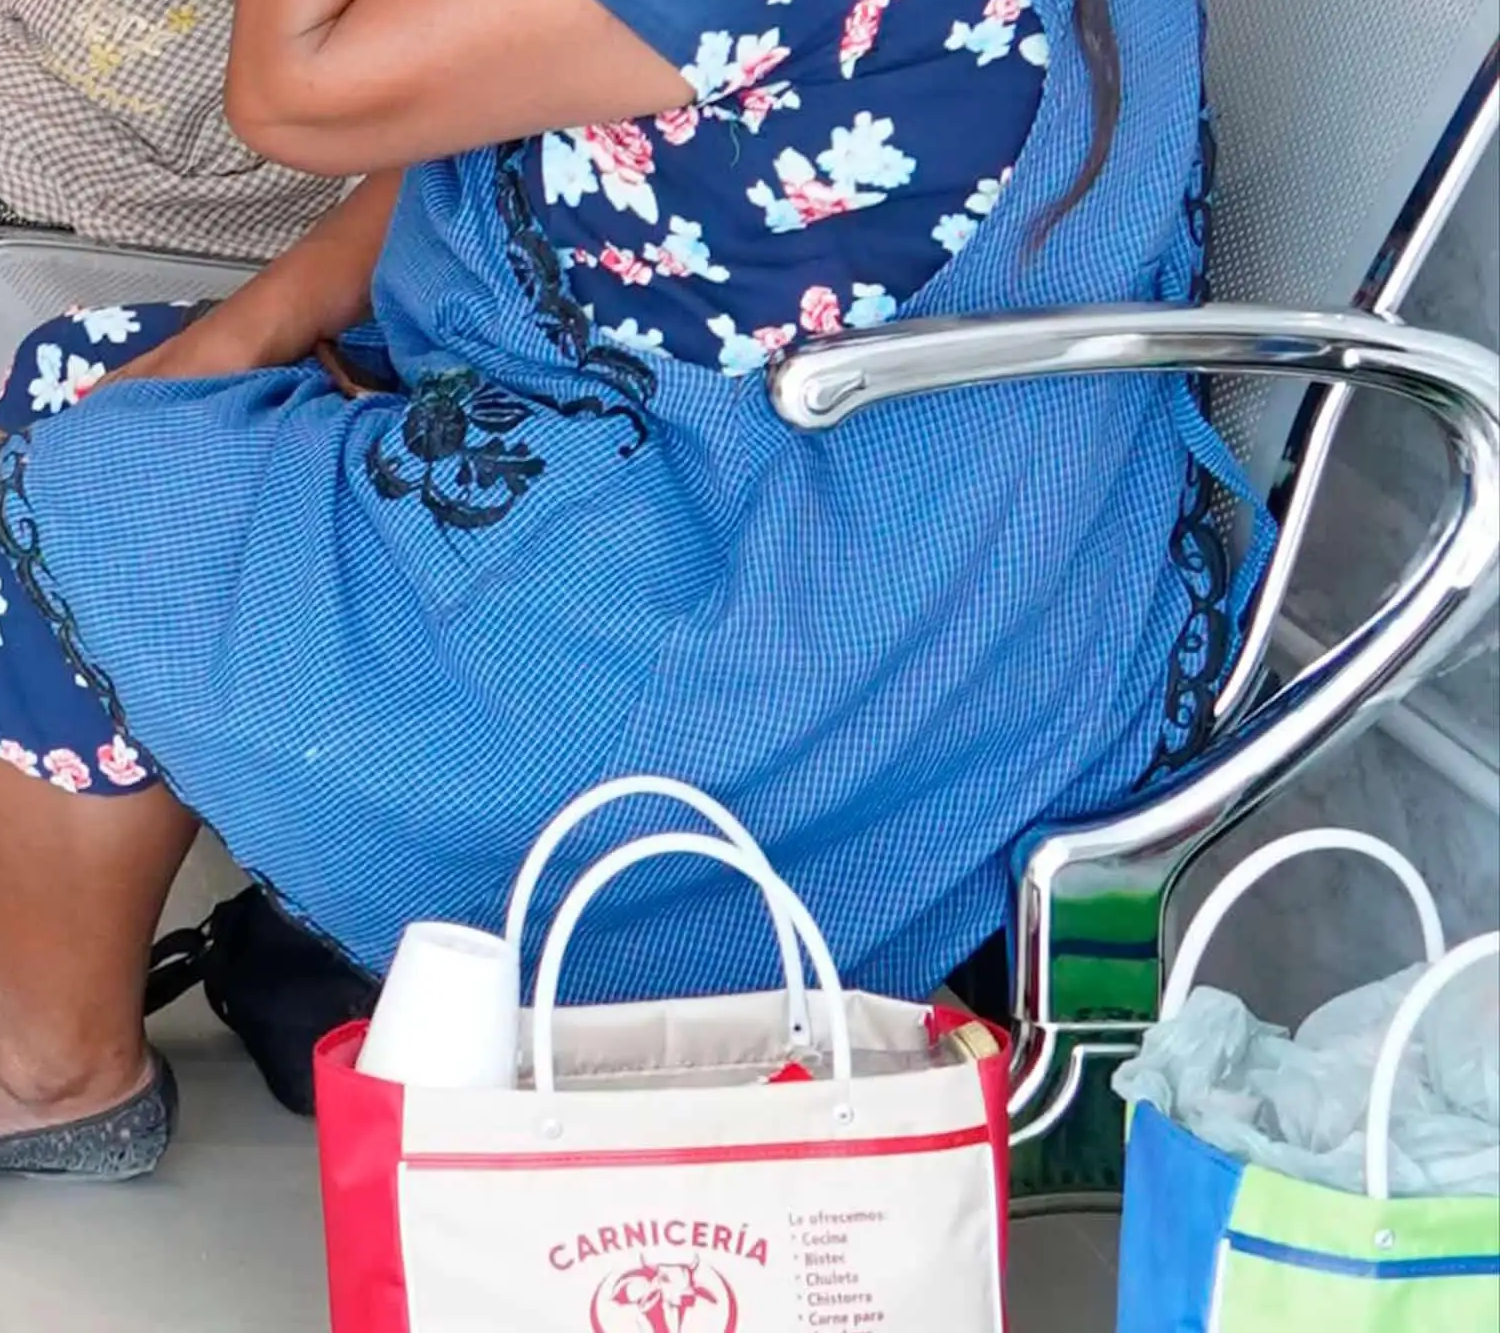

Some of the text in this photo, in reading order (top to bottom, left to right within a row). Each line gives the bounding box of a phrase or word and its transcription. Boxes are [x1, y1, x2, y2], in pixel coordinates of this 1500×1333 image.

[548, 1219, 768, 1271] CARNICERÍA
[807, 1292, 873, 1307] Chistorra
[808, 1312, 849, 1326] Carne
